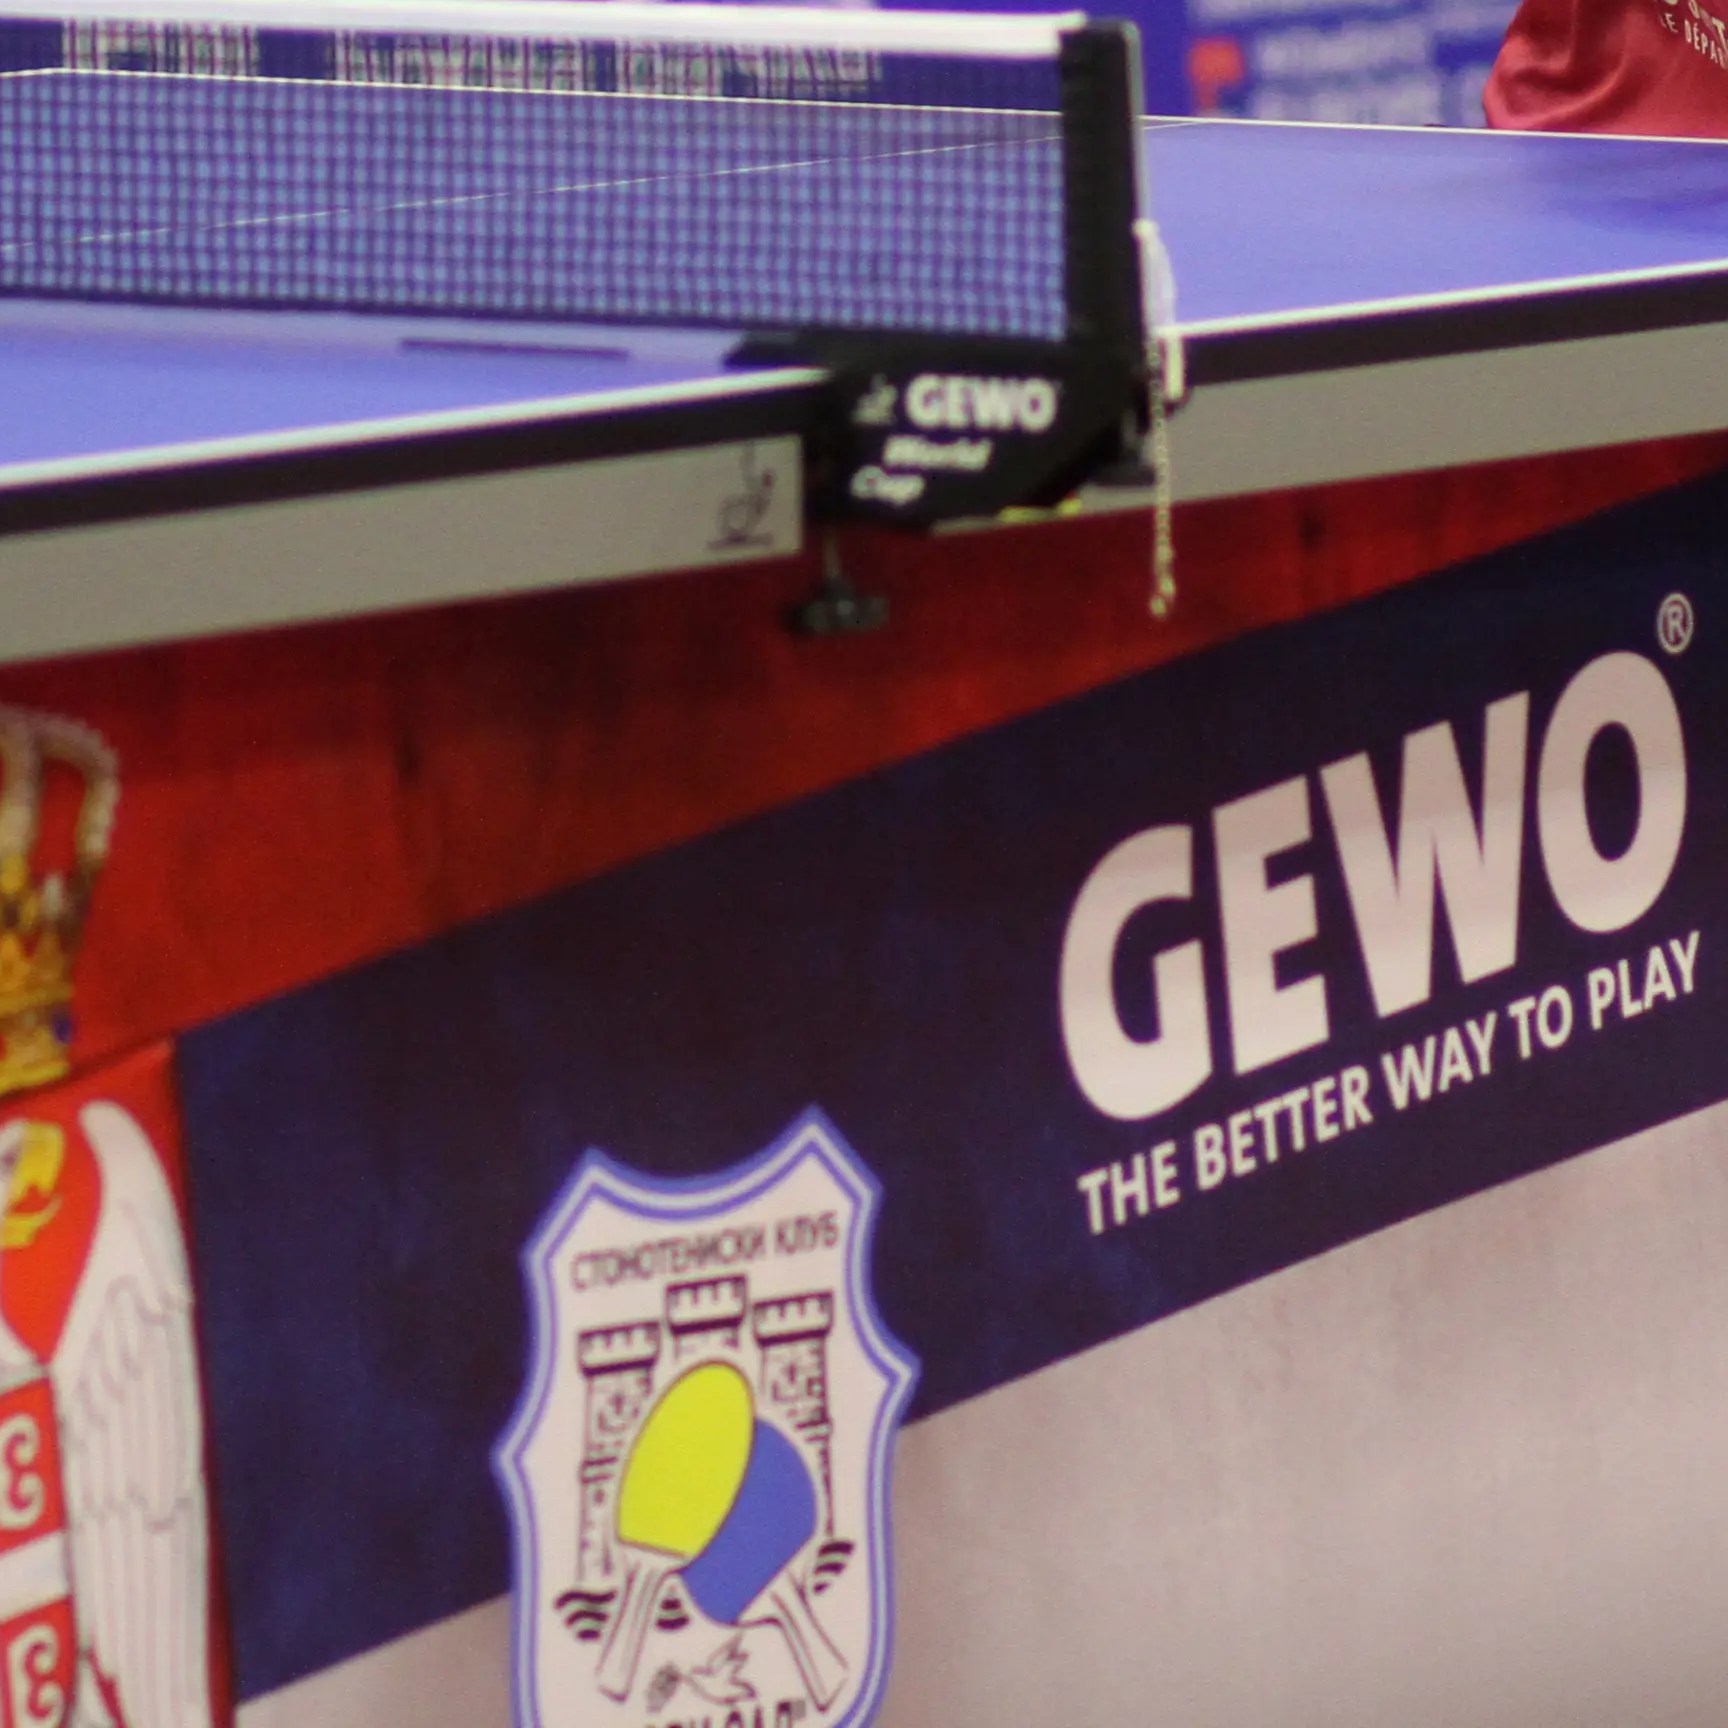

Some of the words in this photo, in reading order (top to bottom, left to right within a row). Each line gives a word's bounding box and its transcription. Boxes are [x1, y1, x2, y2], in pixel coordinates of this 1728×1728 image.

[904, 374, 1058, 434] GEWO
[1059, 649, 1688, 1122] GEWO
[1077, 1141, 1180, 1235] THE
[1192, 1065, 1374, 1201] BETTER
[1380, 1012, 1497, 1111] WAY
[1508, 985, 1575, 1059] TO
[1587, 930, 1702, 1030] PLAY
